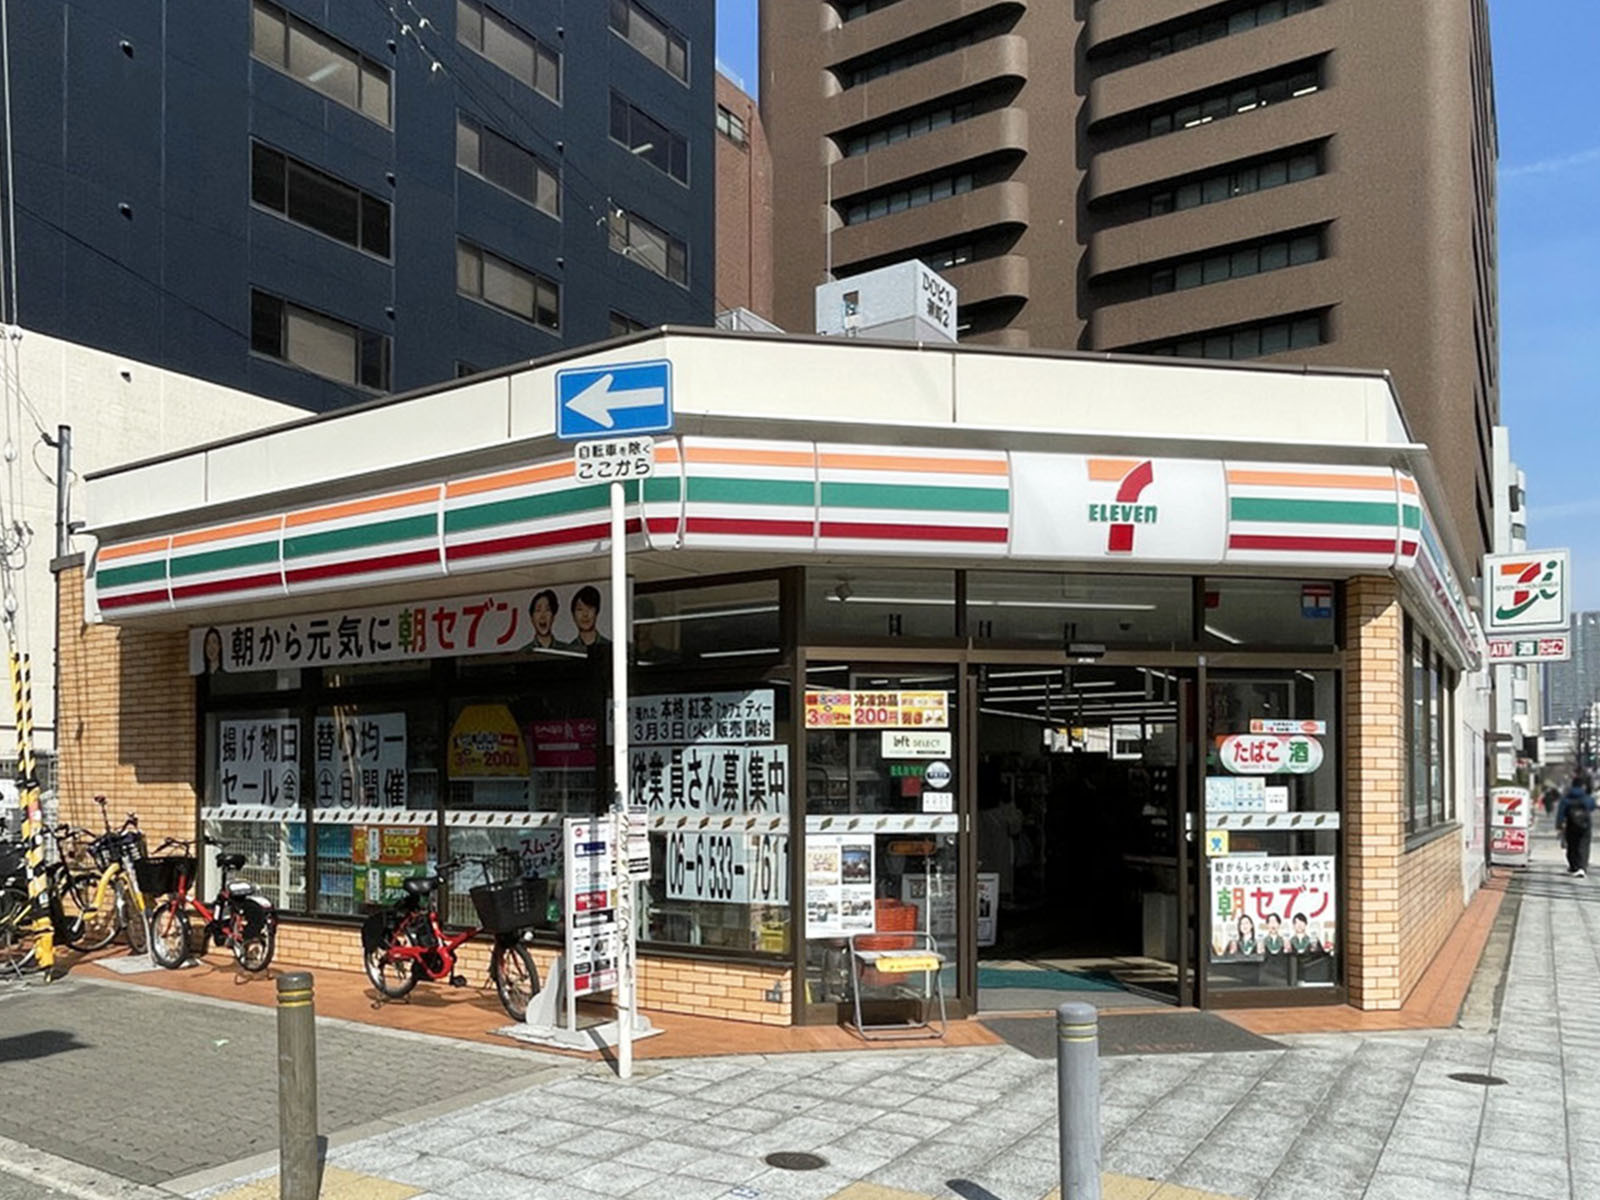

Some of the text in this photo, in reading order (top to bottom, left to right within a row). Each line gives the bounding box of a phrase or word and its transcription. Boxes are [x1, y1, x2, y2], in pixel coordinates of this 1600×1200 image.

[578, 441, 651, 460] 自転車を除く
[579, 458, 651, 480] ここから
[231, 597, 519, 667] 朝から元気に 朝セブン
[1233, 740, 1280, 763] たばこ
[1288, 741, 1309, 763] 酒
[1216, 884, 1329, 922] 朝セブン
